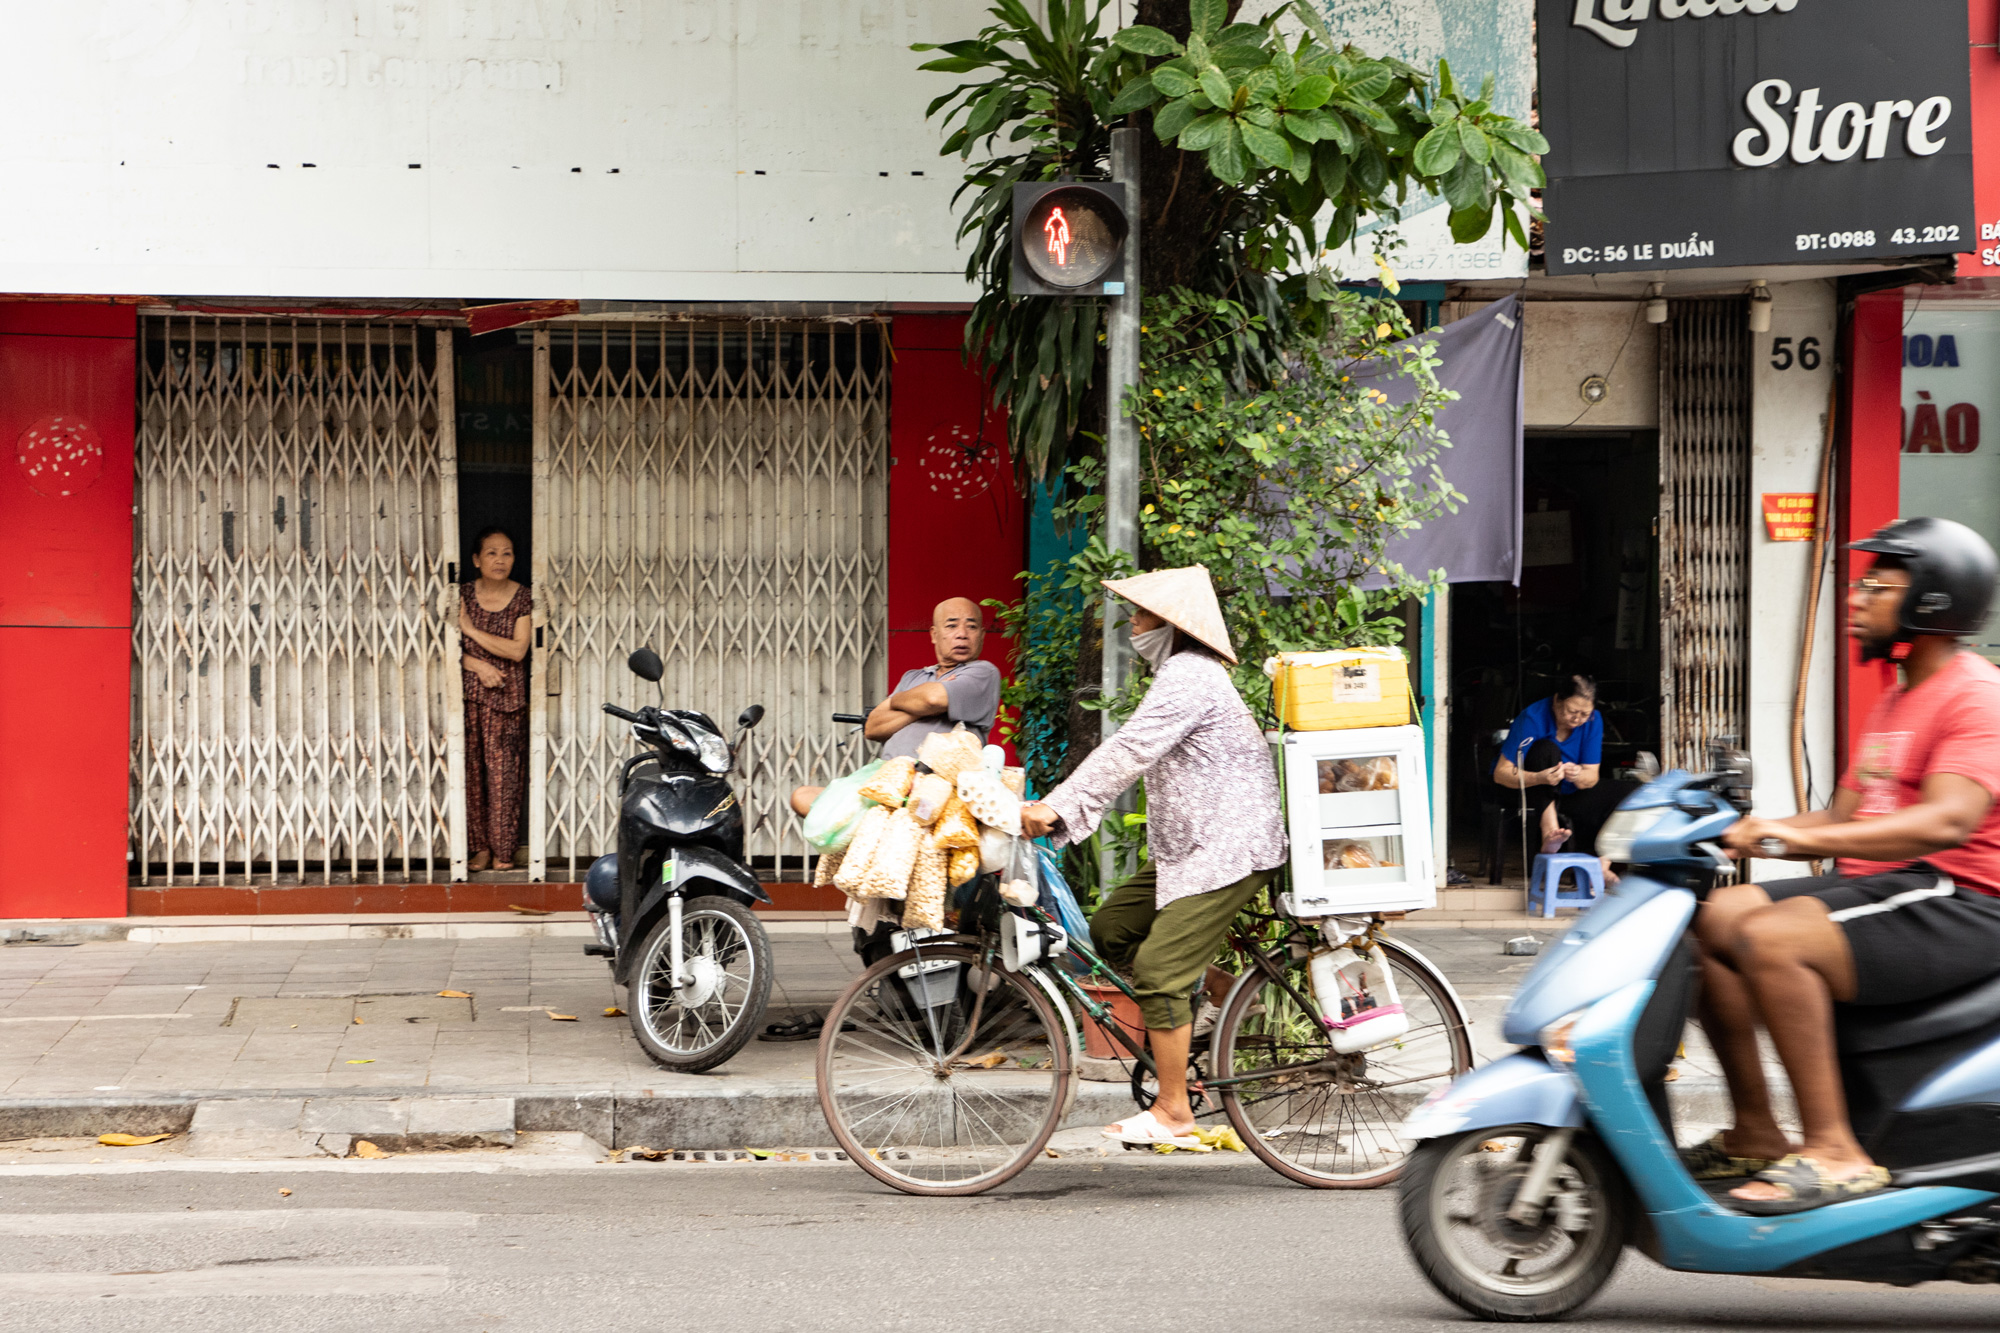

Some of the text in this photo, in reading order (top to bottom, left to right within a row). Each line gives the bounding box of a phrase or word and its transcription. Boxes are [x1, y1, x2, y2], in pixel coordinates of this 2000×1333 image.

[1733, 79, 1952, 167] Store
[1890, 225, 1960, 245] 43.202
[1604, 245, 1628, 262] 56
[1771, 337, 1821, 370] 56
[1900, 390, 1980, 454] ÀO
